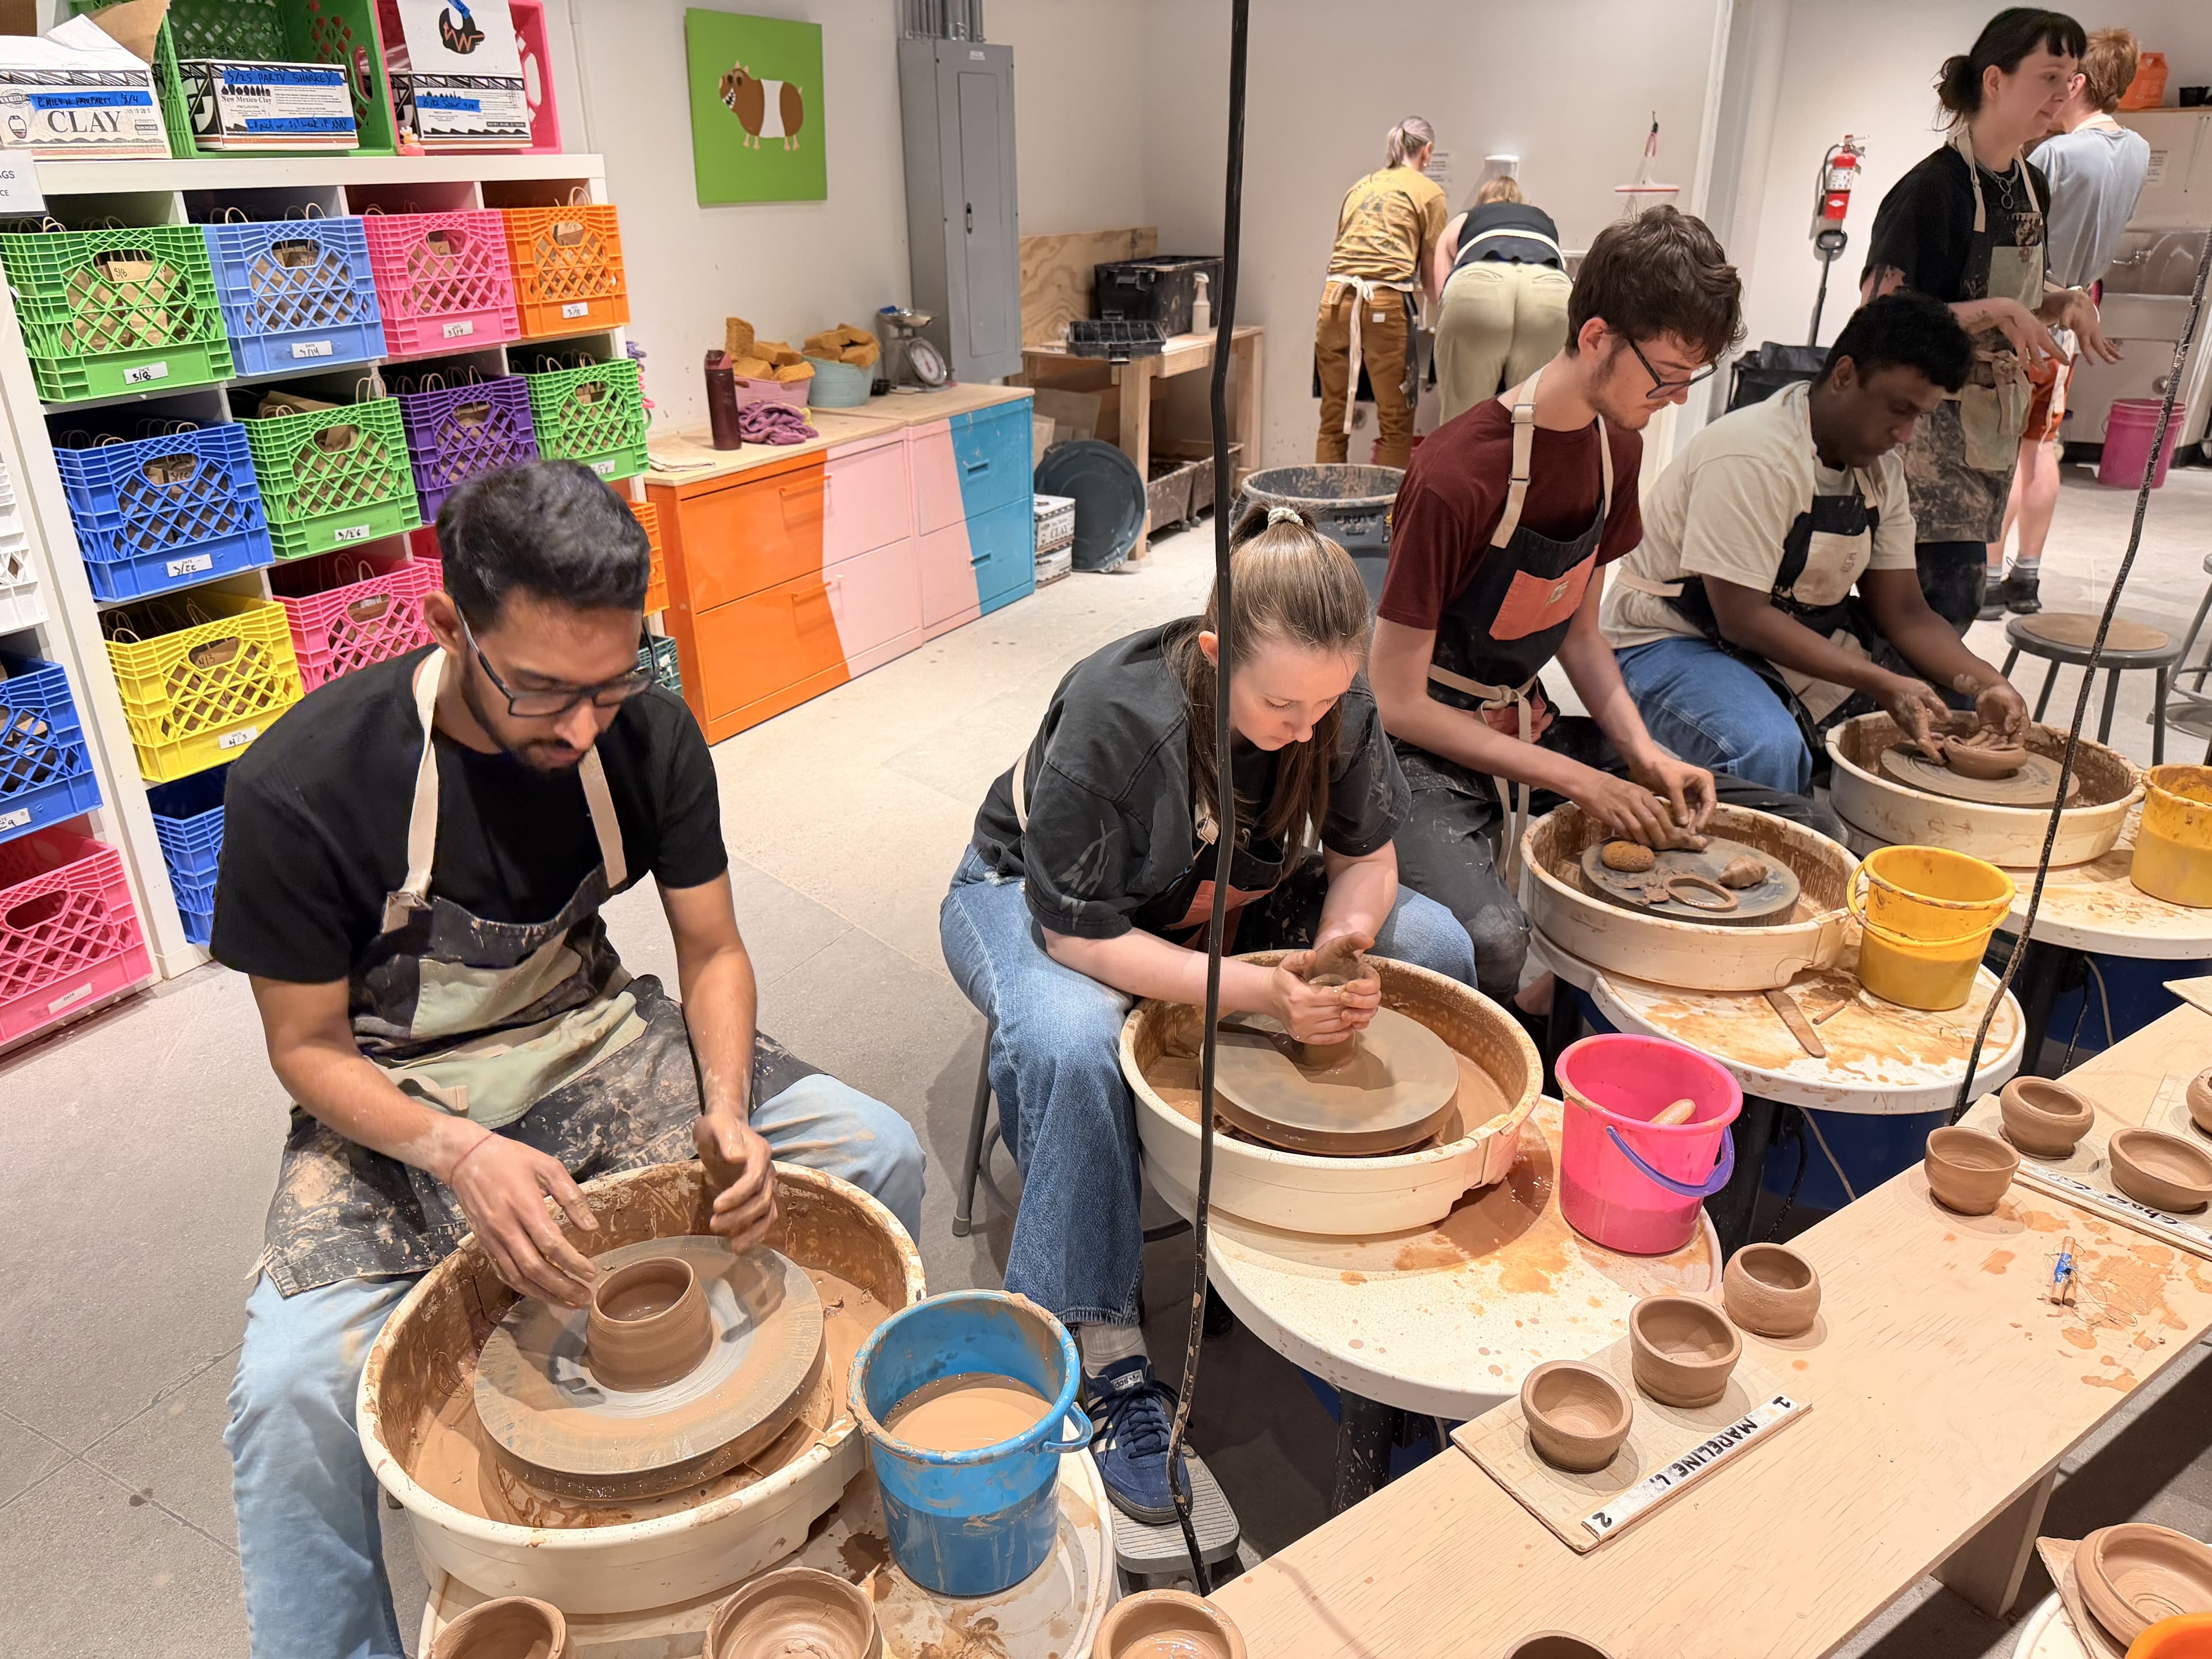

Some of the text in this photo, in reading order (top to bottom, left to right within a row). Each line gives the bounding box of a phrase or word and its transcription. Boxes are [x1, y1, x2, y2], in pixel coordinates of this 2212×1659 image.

[259, 74, 285, 83] PARTY
[47, 111, 121, 132] CLAY
[1678, 1418, 1758, 1478] MADELINE
[1592, 1511, 1613, 1528] 2
